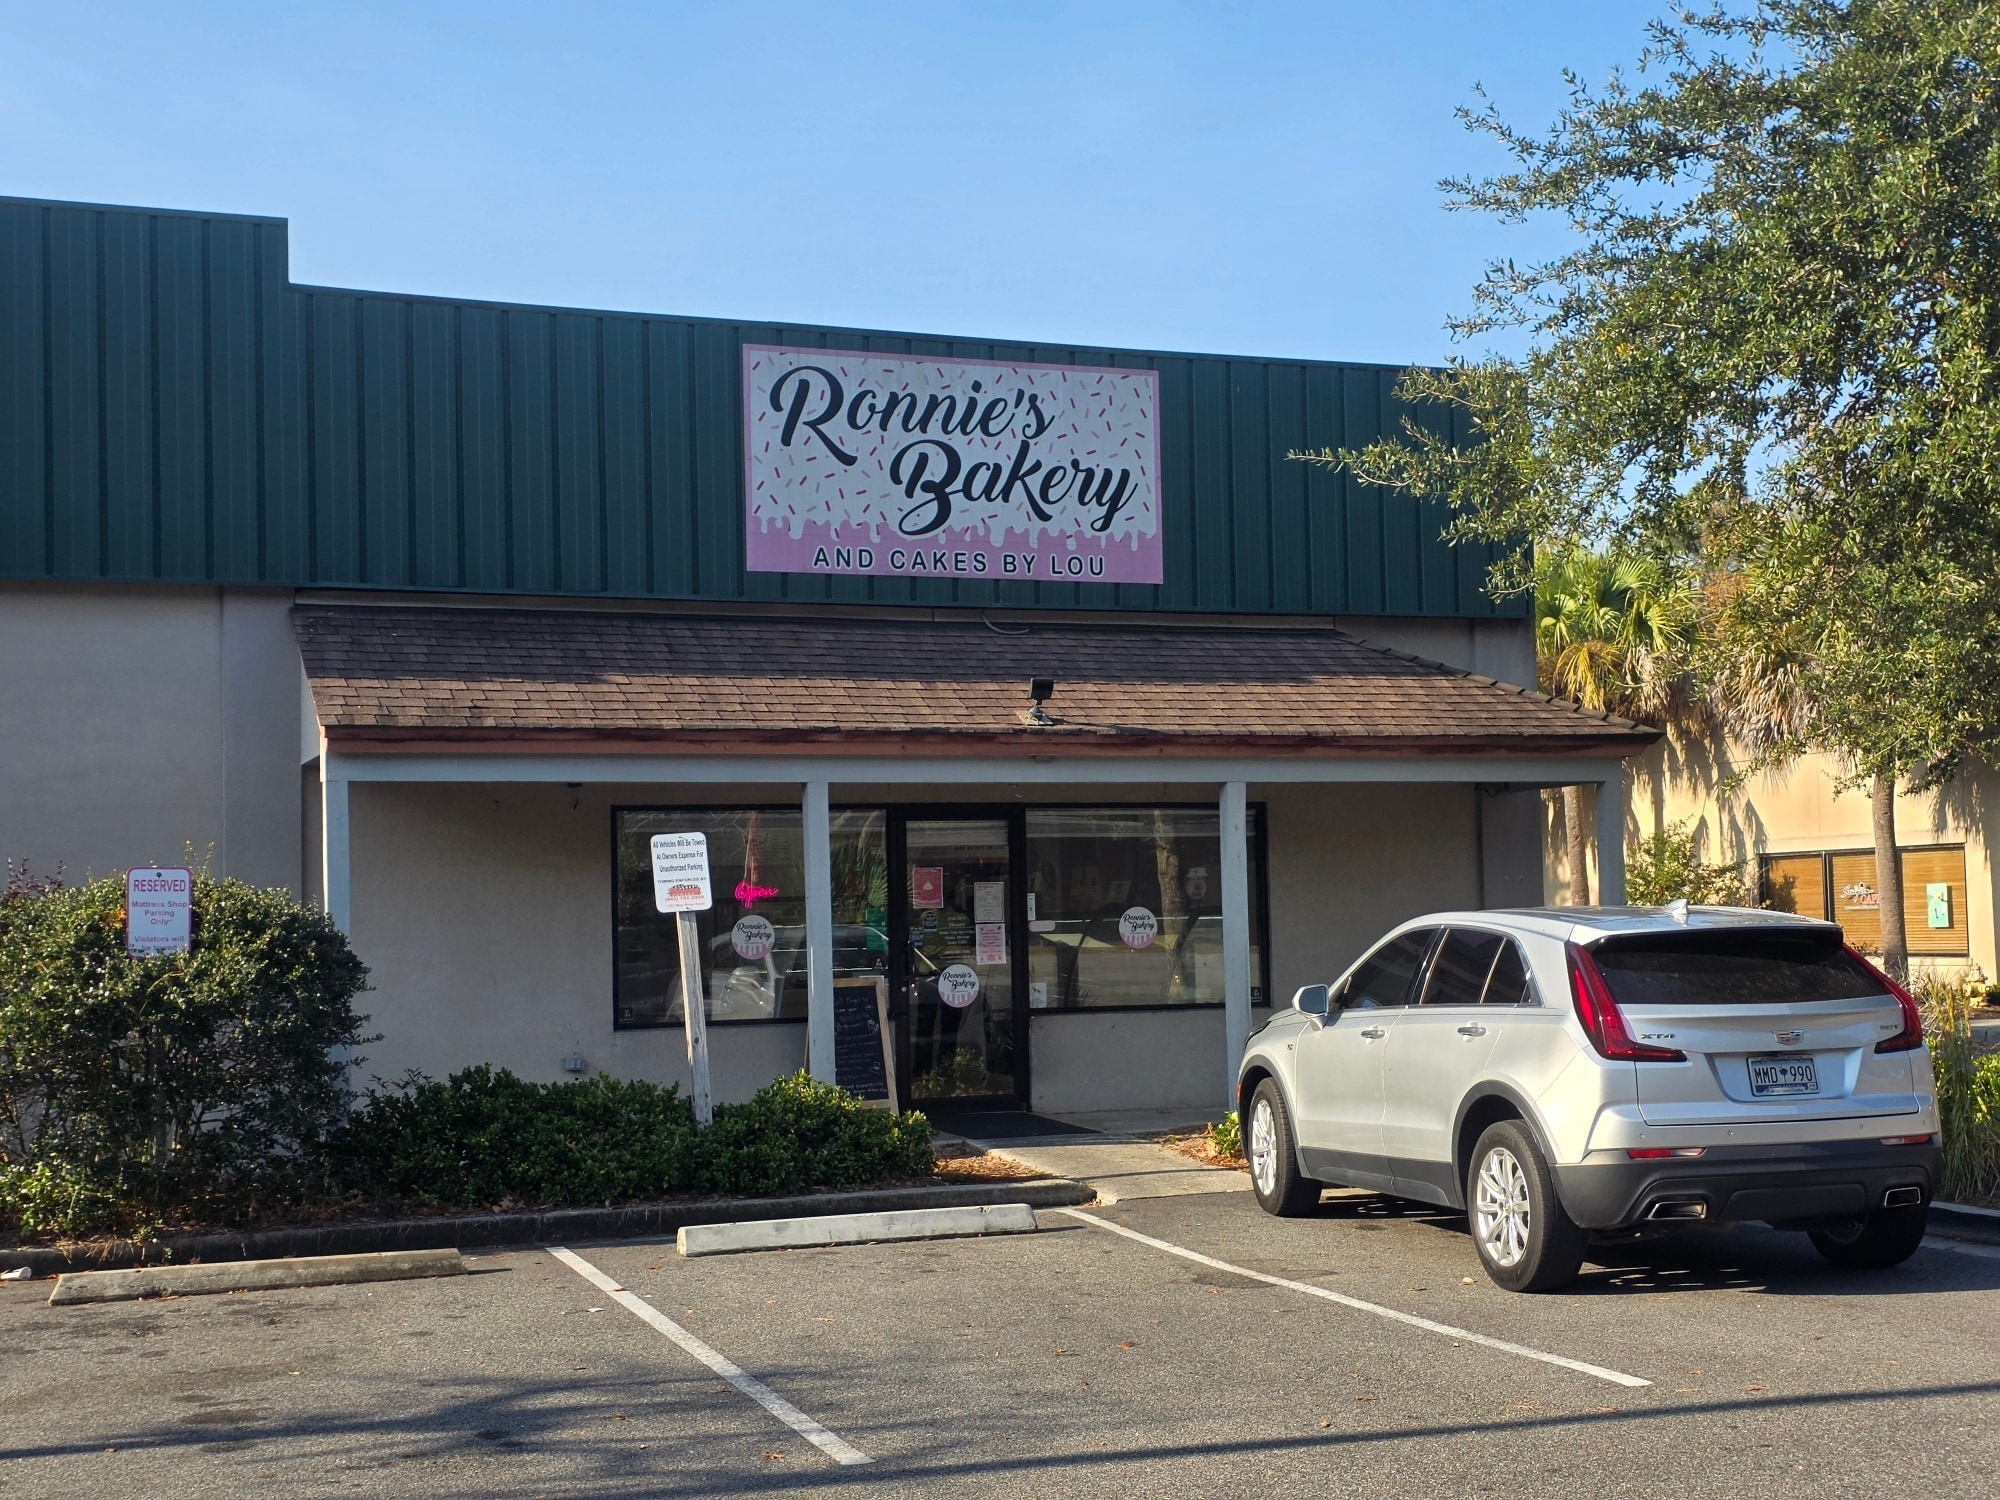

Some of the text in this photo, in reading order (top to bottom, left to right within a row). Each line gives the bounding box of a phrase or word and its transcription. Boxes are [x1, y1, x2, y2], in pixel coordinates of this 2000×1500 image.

[769, 365, 1055, 467] Ronnie's
[890, 438, 1138, 536] Bakery
[813, 547, 1105, 577] AND CAKES BY LOU
[677, 839, 685, 847] Will
[692, 838, 705, 846] Towed
[662, 852, 678, 860] Owners
[678, 851, 696, 860] Expense
[659, 863, 703, 872] Unauthorized Parking
[133, 879, 186, 892] RESERVED
[734, 881, 779, 909] Open
[1131, 921, 1155, 932] Bakery
[744, 931, 772, 942] Bakery
[951, 980, 976, 991] Bakery
[1754, 1065, 1813, 1084] MMD 990
